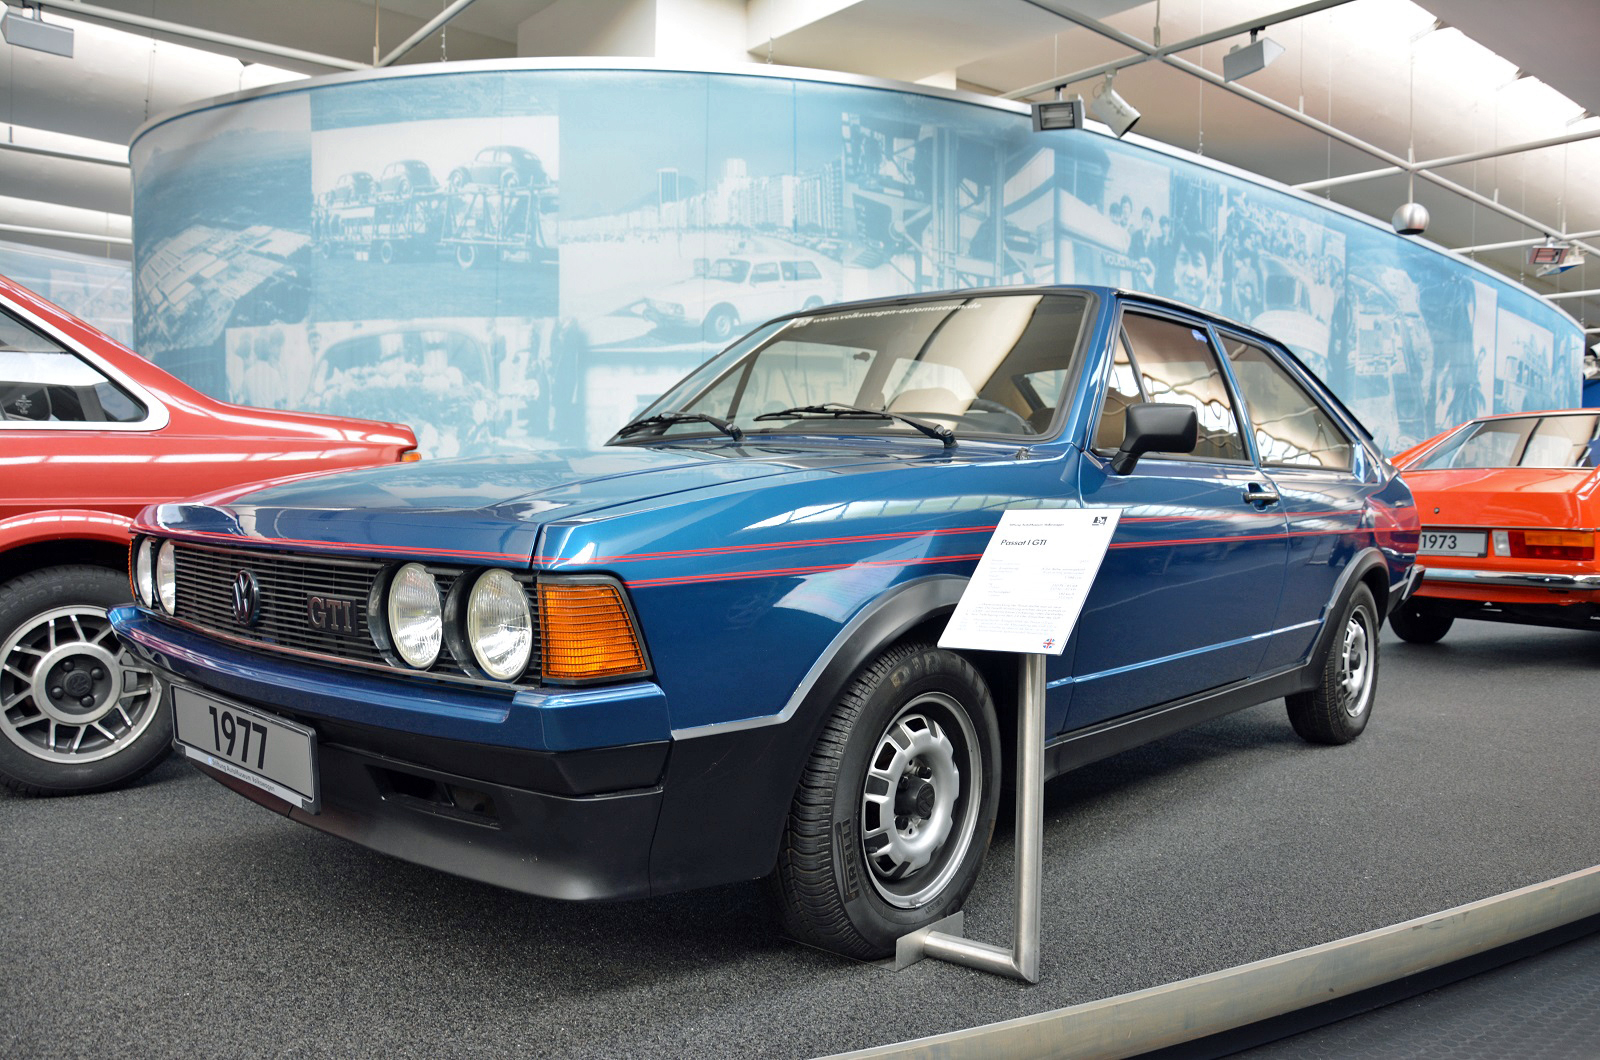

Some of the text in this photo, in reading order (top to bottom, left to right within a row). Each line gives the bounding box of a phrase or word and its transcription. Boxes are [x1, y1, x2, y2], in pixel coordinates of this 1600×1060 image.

[1000, 538, 1027, 546] Passat
[1032, 538, 1048, 546] GTI
[1421, 535, 1458, 550] 1973
[308, 596, 353, 633] GTI
[208, 705, 268, 770] 1977
[834, 818, 860, 904] PIRELLI
